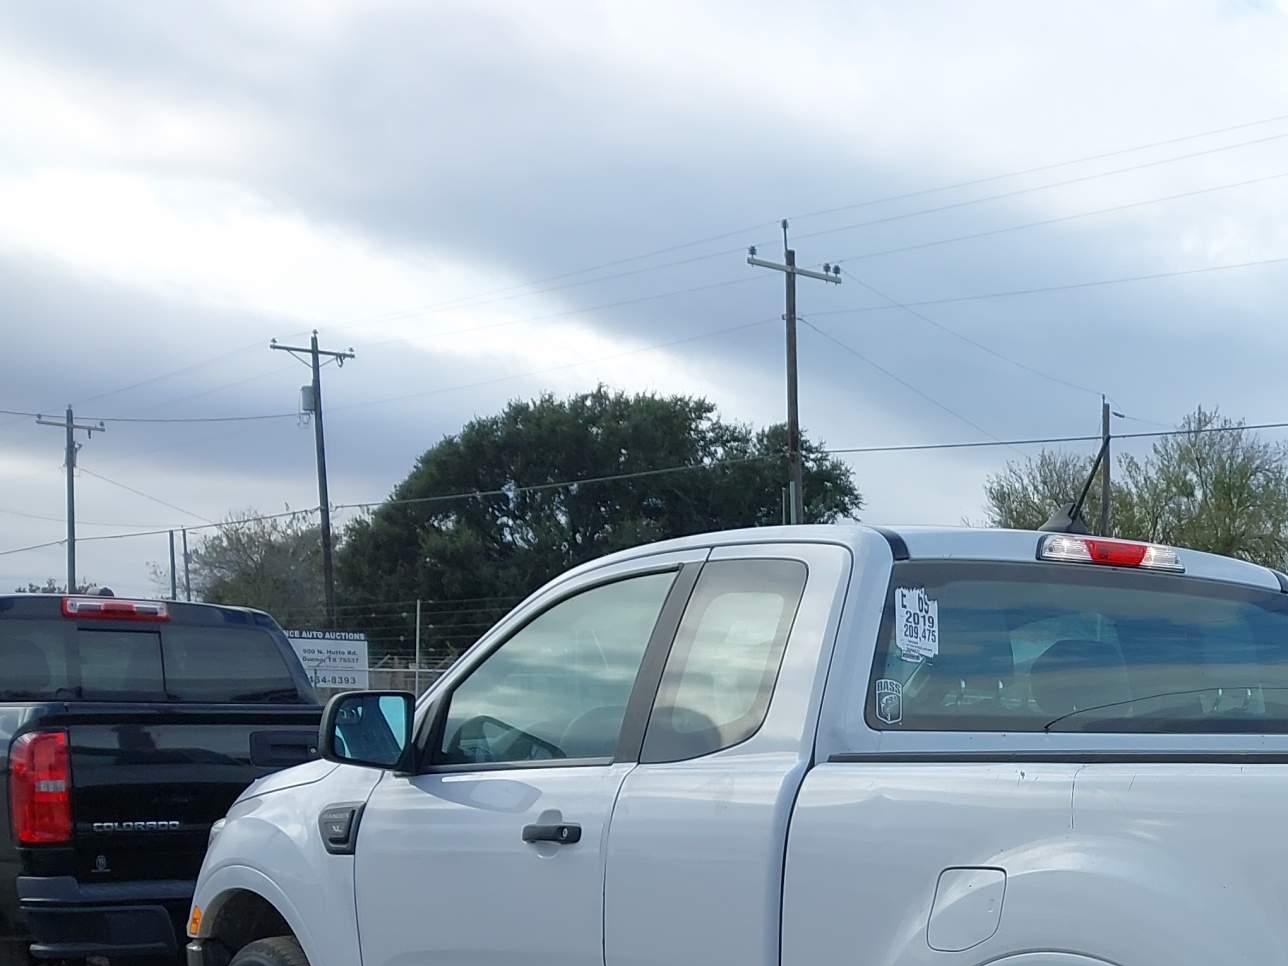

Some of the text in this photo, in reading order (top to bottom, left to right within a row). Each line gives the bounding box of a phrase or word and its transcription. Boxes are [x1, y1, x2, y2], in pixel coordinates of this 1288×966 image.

[905, 610, 935, 629] 2019
[301, 631, 323, 639] AUTO
[325, 632, 365, 641] AUCTIONS
[903, 624, 937, 644] 209,475
[92, 820, 181, 832] COLORADO
